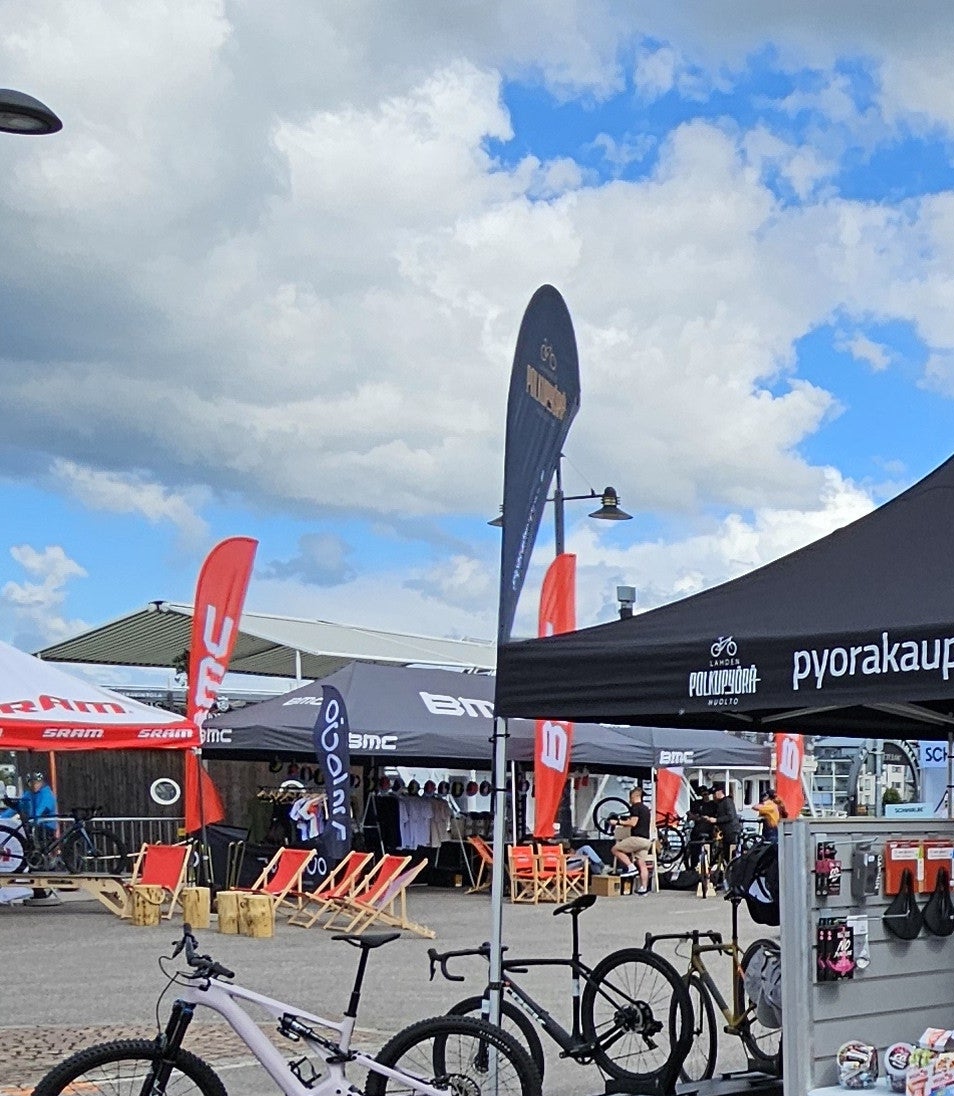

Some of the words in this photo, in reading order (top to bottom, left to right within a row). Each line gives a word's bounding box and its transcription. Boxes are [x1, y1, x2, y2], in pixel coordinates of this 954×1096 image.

[709, 658, 741, 667] LAHDEN
[282, 696, 324, 706] BMC
[419, 692, 495, 718] BM
[43, 728, 102, 738] SRAM
[138, 728, 193, 738] SRAM
[349, 732, 398, 750] BMC
[659, 750, 694, 764] BMC
